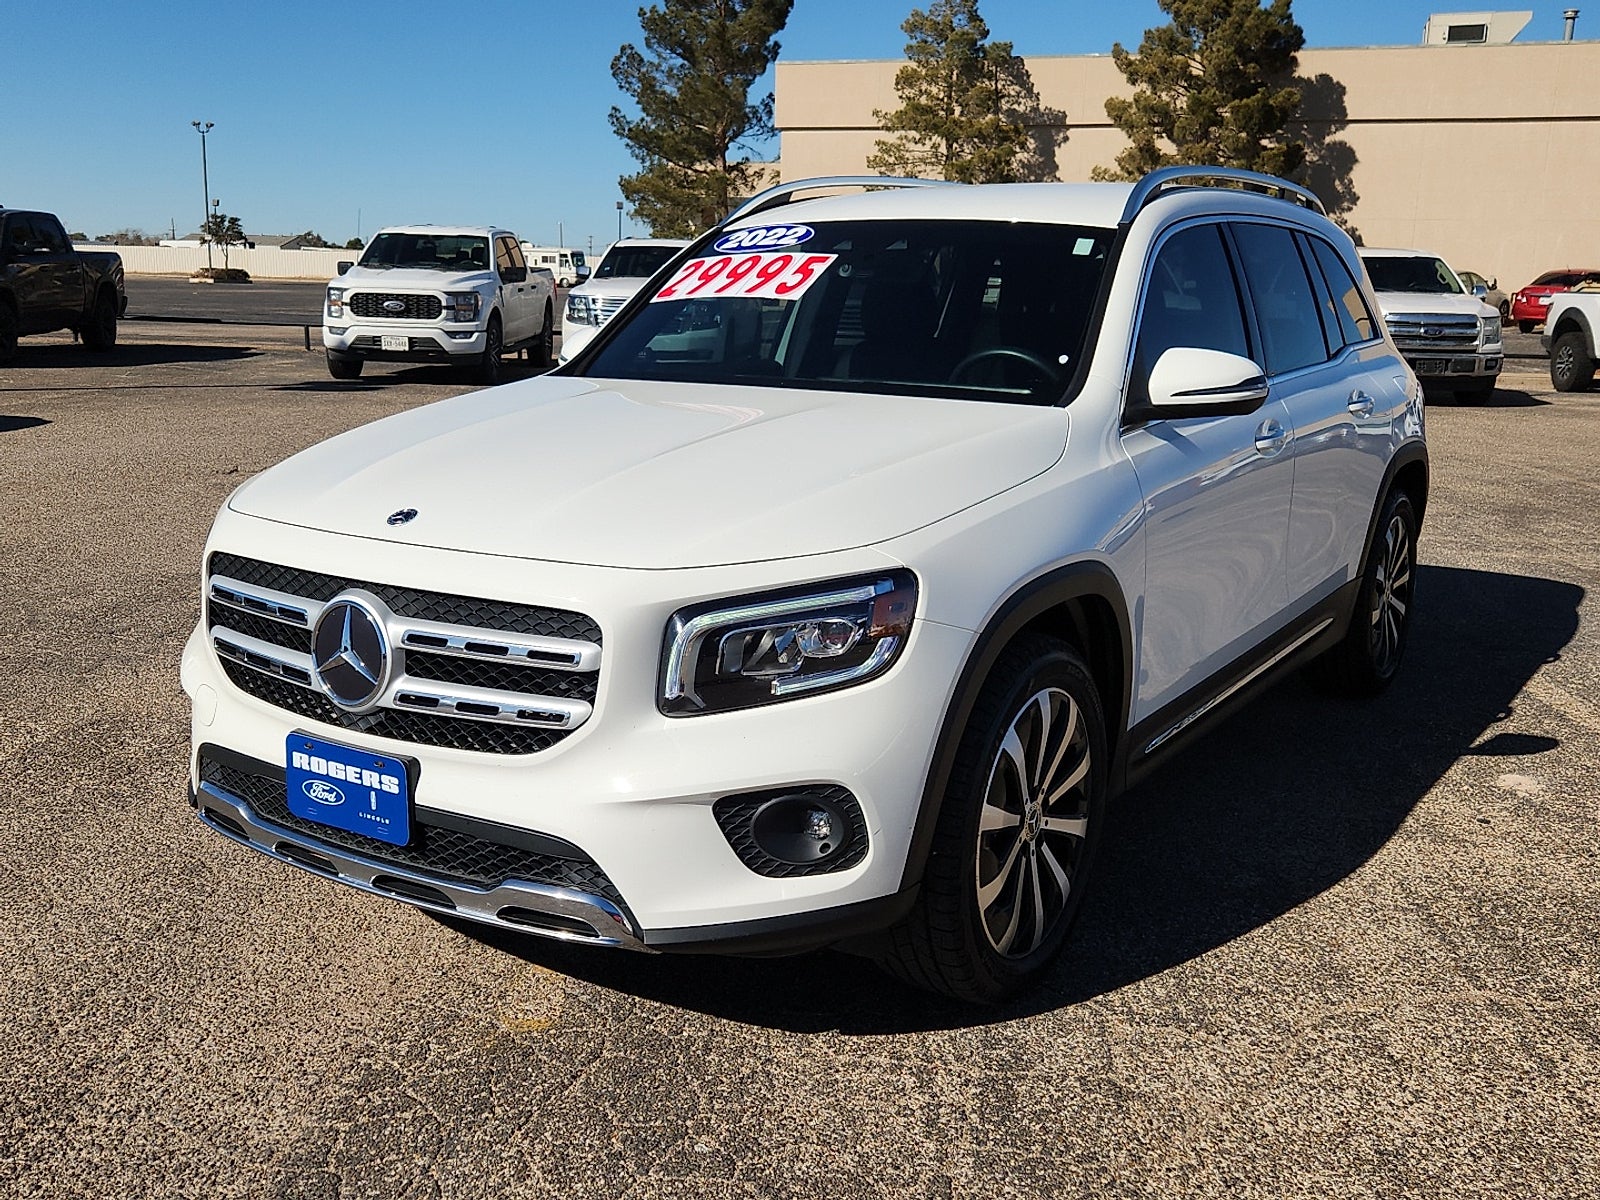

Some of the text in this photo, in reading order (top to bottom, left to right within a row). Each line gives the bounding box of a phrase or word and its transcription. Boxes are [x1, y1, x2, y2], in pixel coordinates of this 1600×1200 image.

[721, 228, 807, 249] 2022
[657, 255, 831, 298] 29995
[292, 751, 400, 795] ROGERS
[309, 782, 337, 802] Ford
[358, 811, 390, 825] LINCOLN
